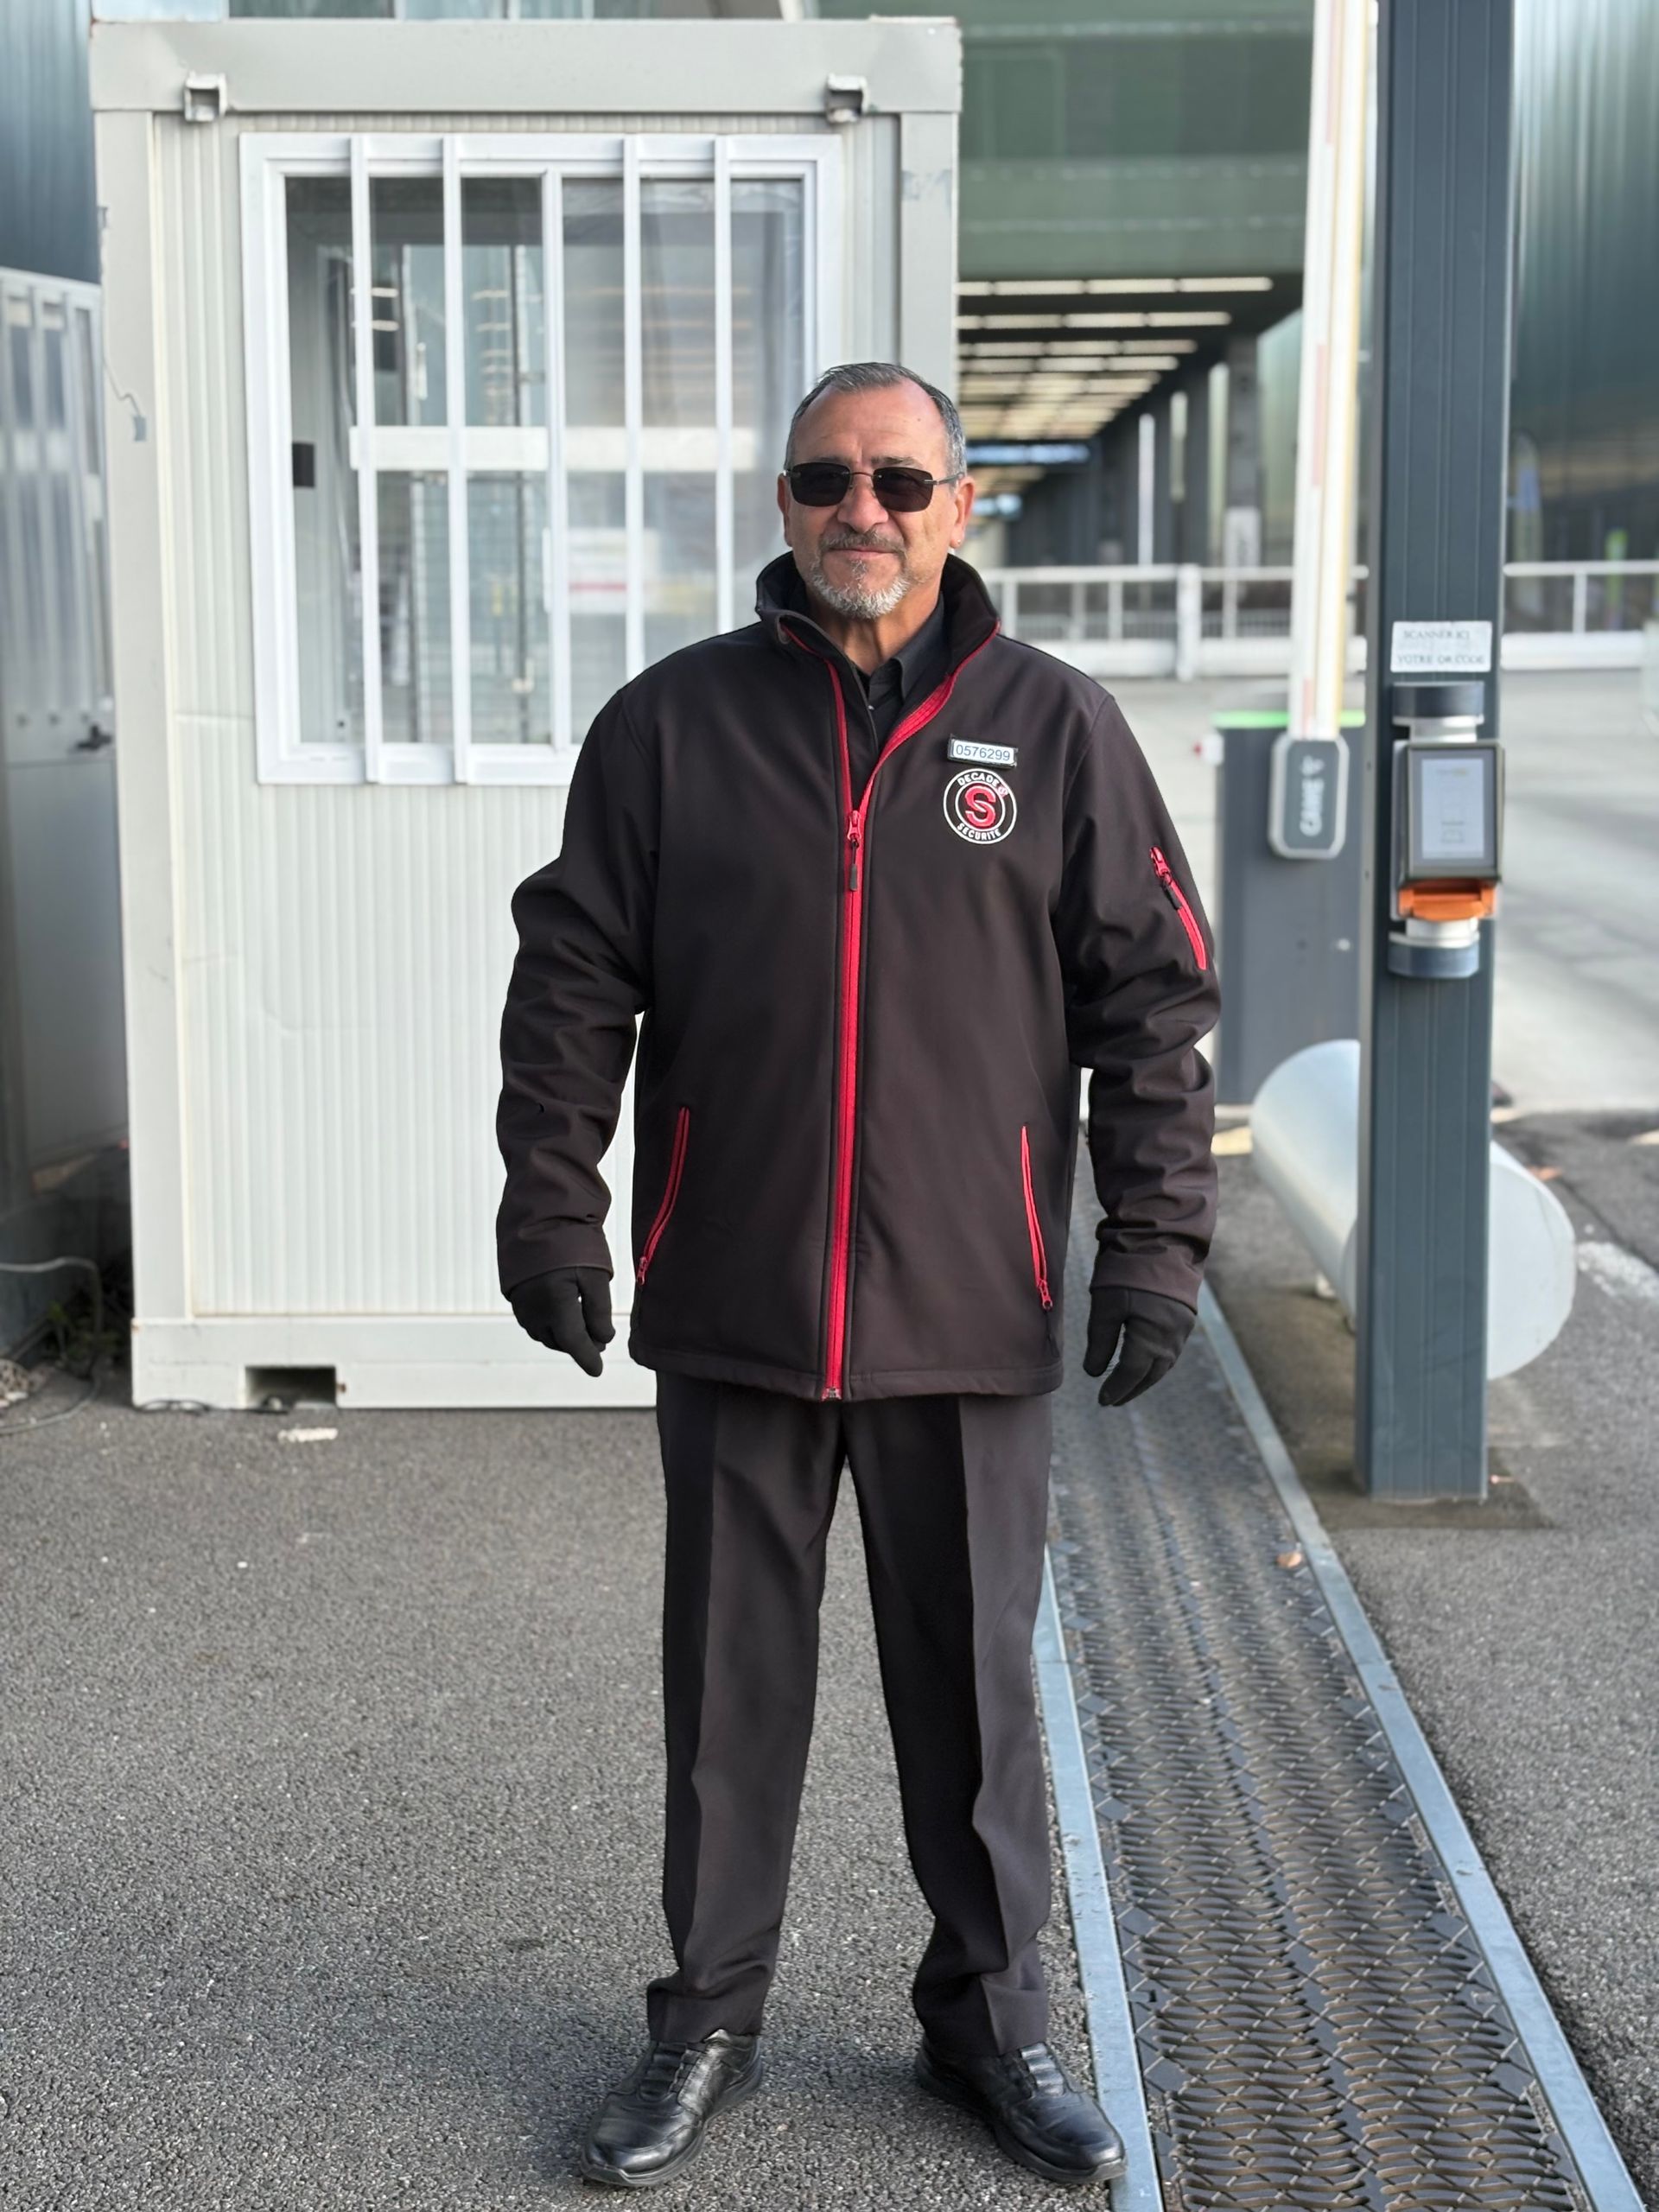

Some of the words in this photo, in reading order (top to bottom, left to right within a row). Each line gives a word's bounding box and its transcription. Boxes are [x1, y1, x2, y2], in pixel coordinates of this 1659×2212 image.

[1403, 629, 1452, 639] SCANNER
[1398, 654, 1433, 664] VOTRE
[956, 744, 1010, 761] 0576299
[957, 772, 1000, 787] DECADE
